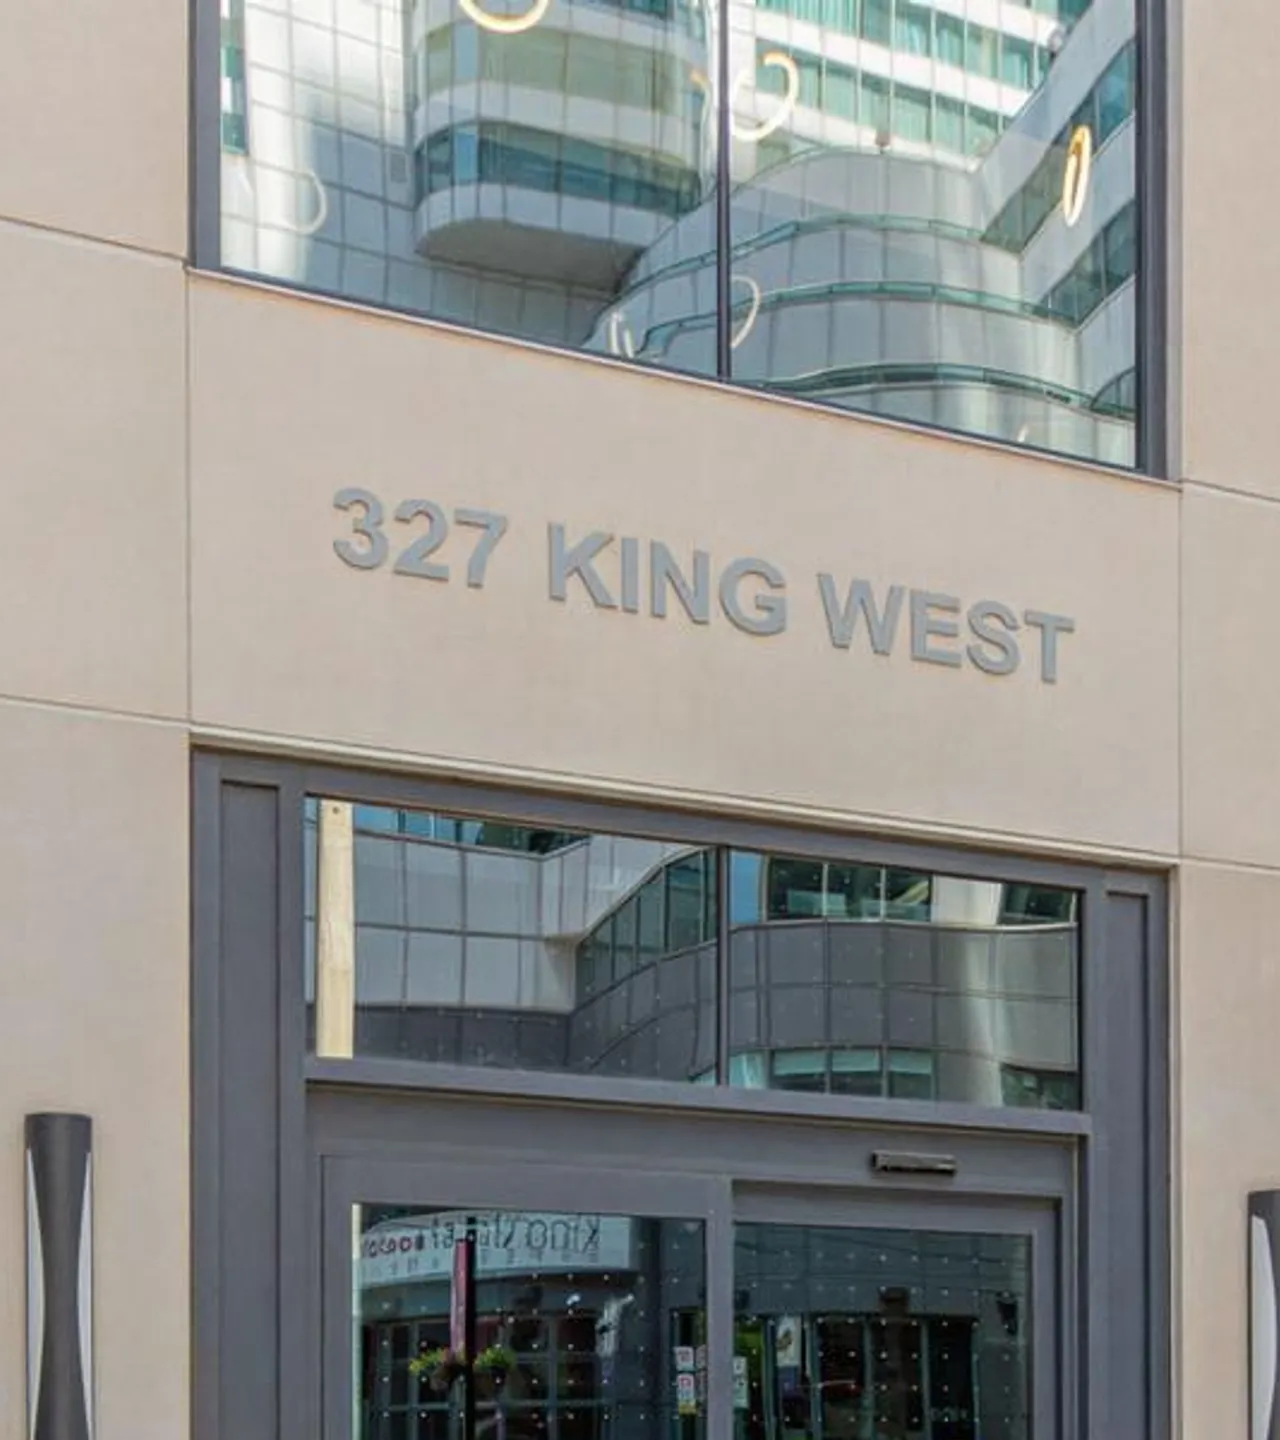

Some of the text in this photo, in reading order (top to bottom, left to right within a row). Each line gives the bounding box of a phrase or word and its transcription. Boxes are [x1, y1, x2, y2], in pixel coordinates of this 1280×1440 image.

[332, 487, 1075, 685] 327 KING WEST
